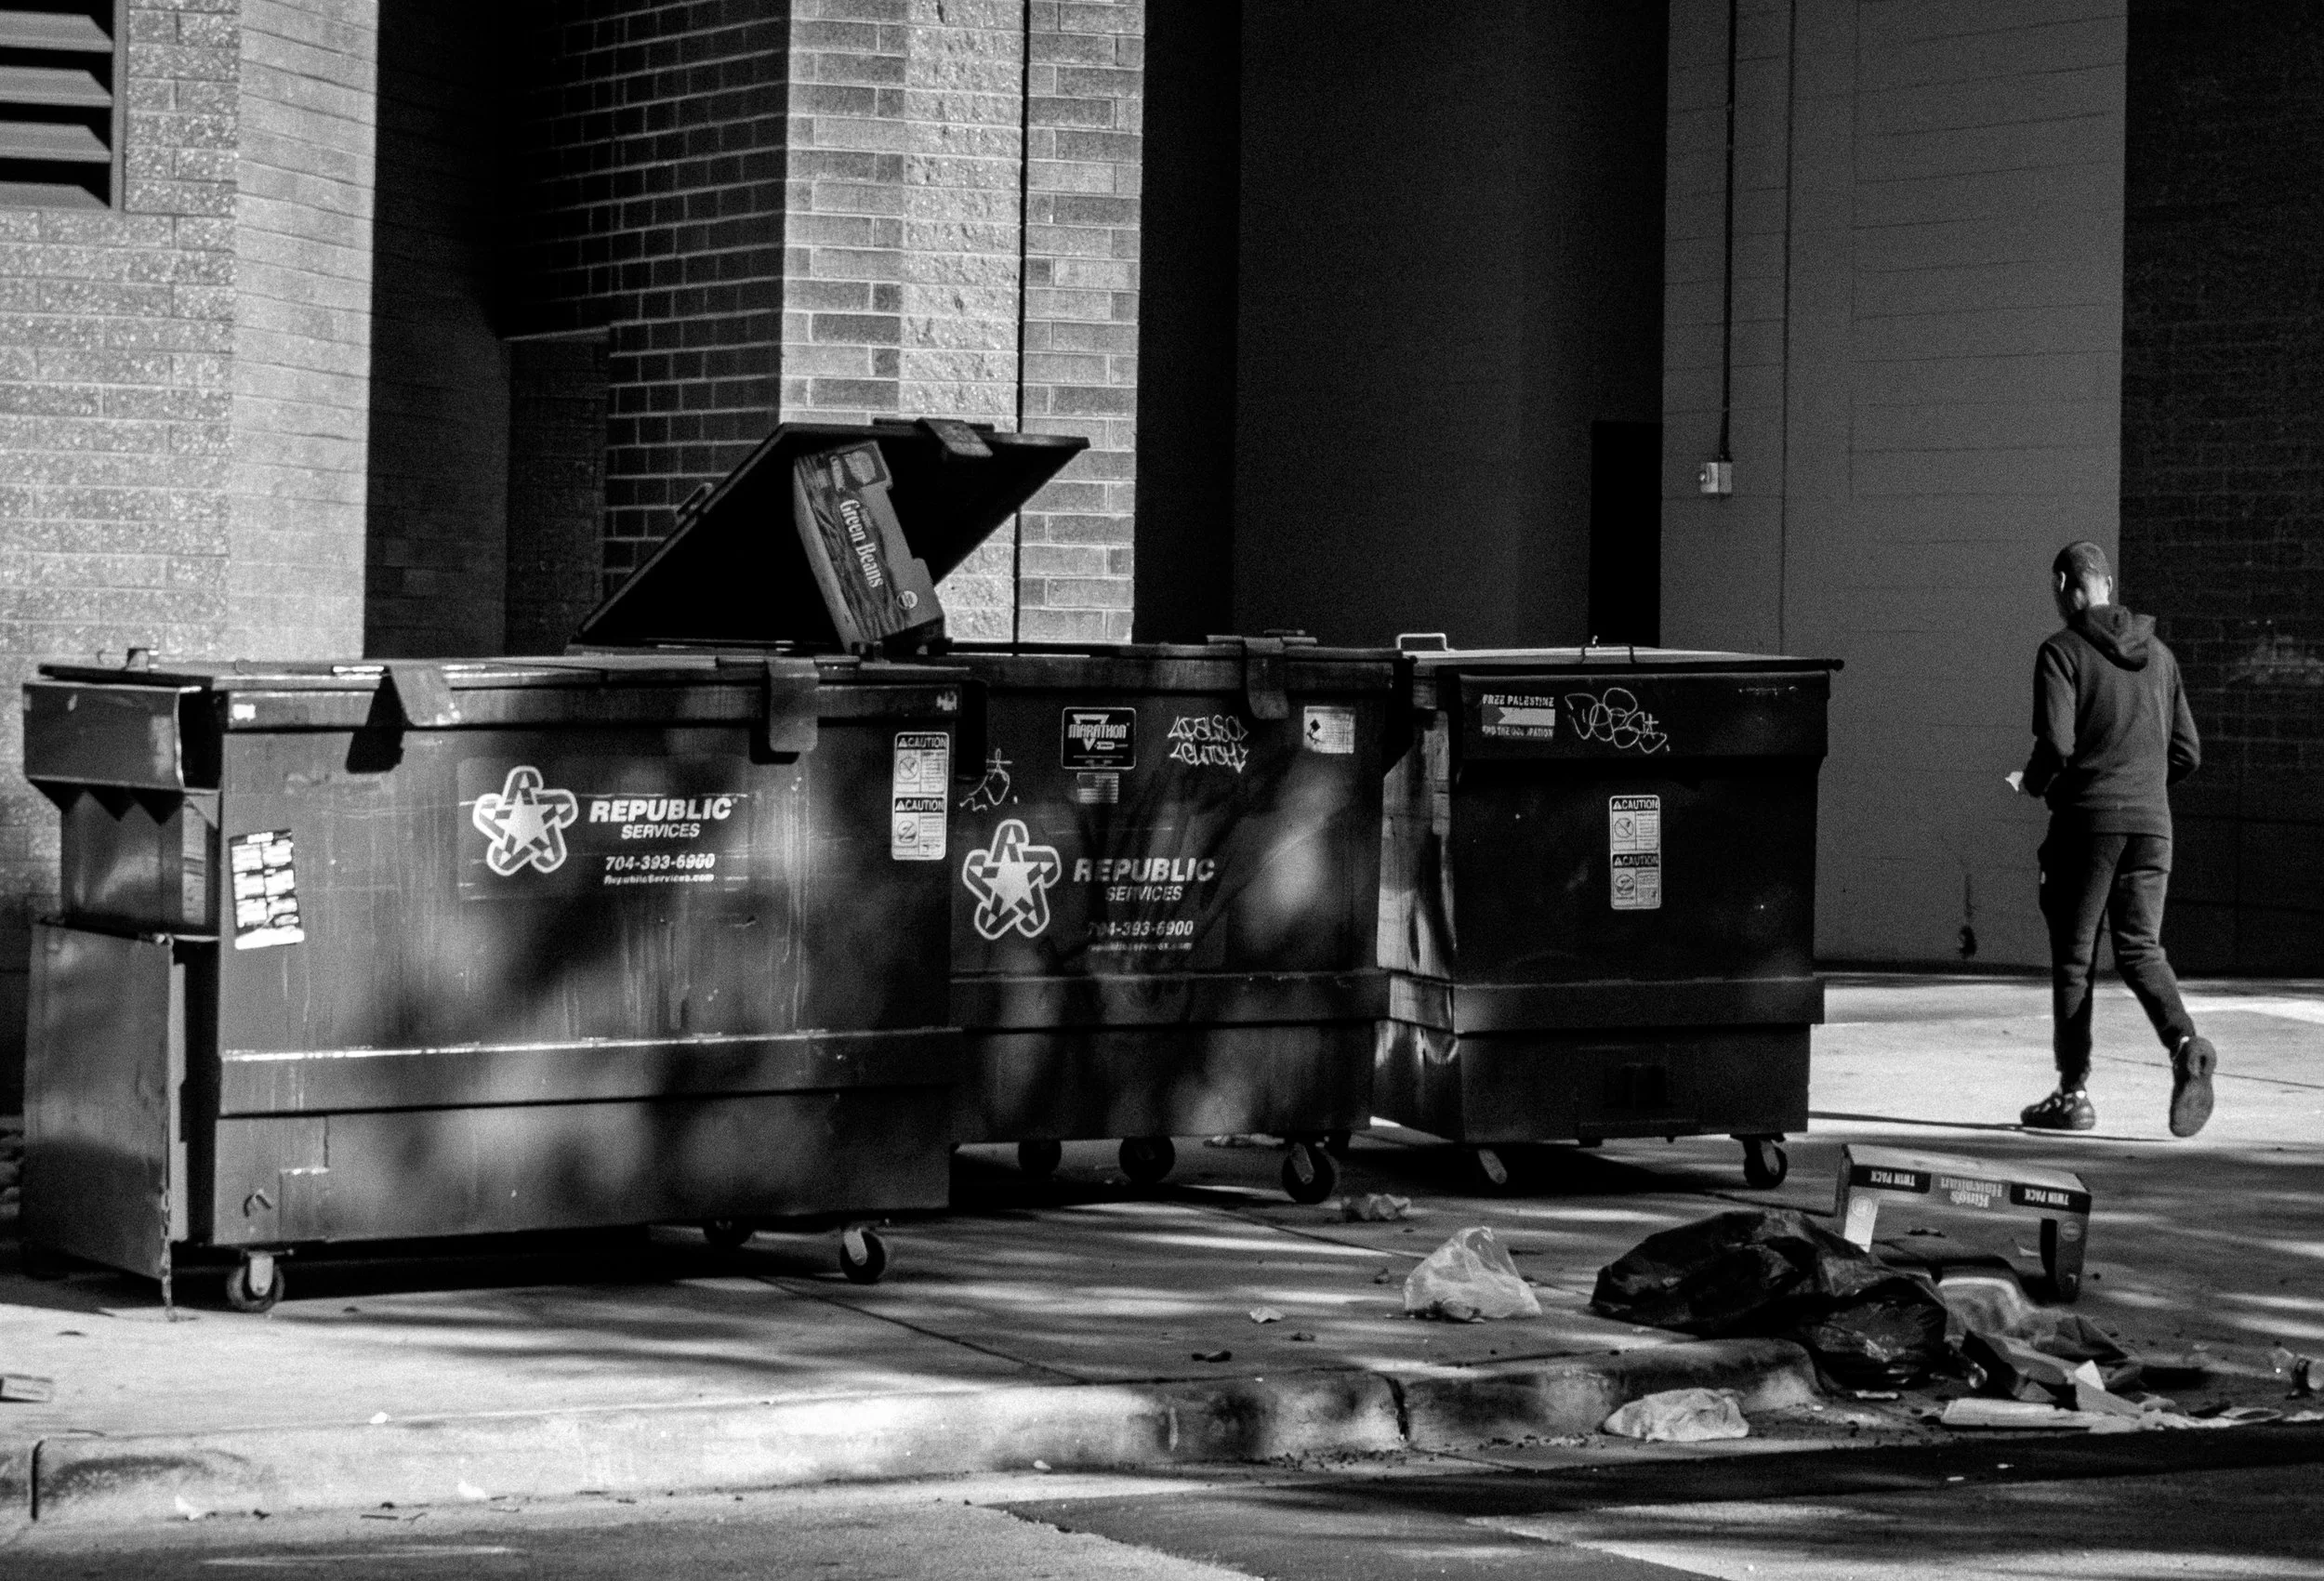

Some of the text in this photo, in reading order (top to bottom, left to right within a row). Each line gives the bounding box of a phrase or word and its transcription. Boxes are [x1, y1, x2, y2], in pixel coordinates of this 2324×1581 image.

[839, 498, 866, 544] Green
[855, 541, 884, 588] Beans
[1482, 693, 1555, 707] FREE PALESTINE
[1067, 723, 1127, 739] MARATHON
[907, 737, 946, 748] CAUTION
[588, 797, 733, 823] REPUBLIC
[905, 799, 944, 811] CAUTION
[1621, 799, 1658, 810] CAUTION
[621, 823, 701, 839] SERVICES
[605, 852, 716, 871] 704-393-6900
[1622, 856, 1658, 866] CAUTION
[1073, 857, 1215, 882] REPUBLIC
[1870, 1170, 1916, 1187] TWIN PACK
[2024, 1188, 2069, 1206] TWIN PACK
